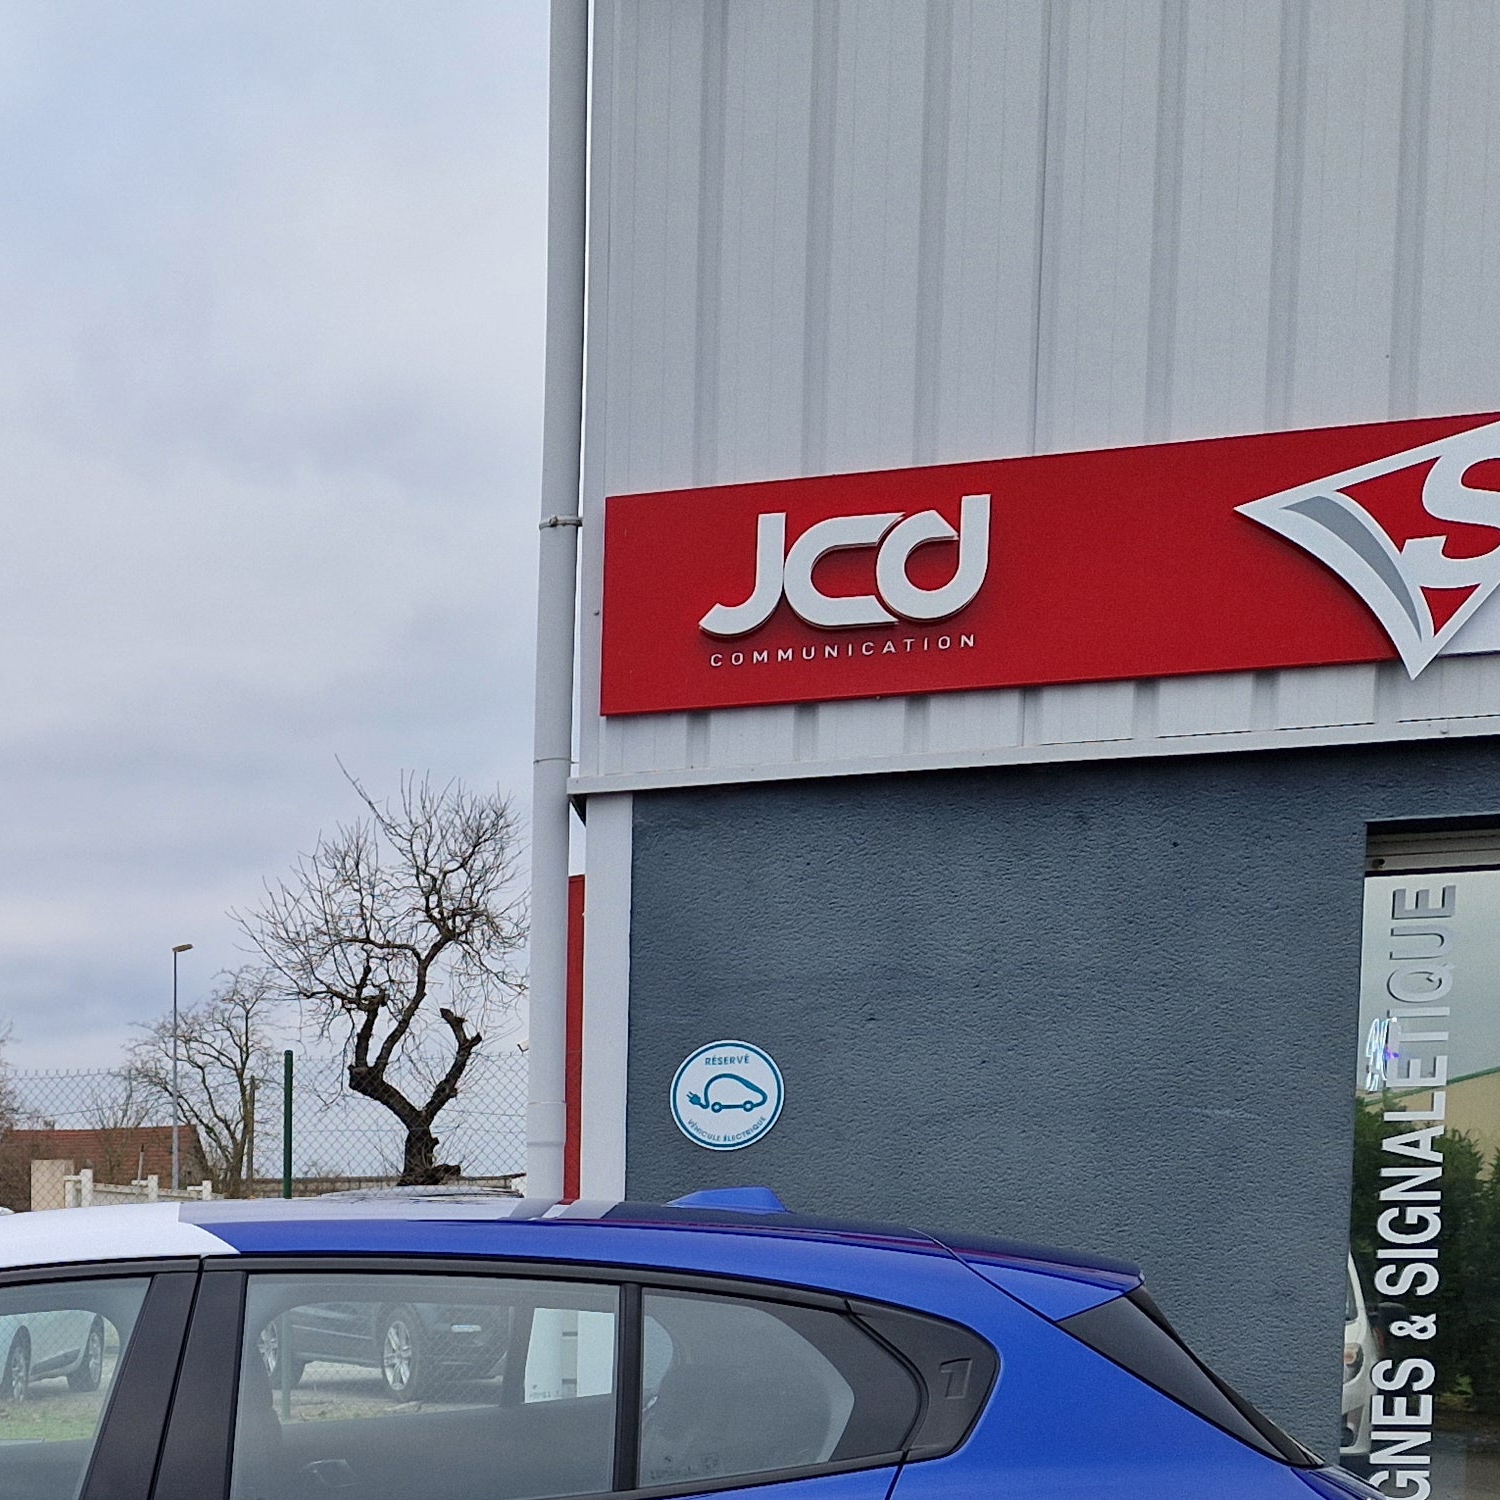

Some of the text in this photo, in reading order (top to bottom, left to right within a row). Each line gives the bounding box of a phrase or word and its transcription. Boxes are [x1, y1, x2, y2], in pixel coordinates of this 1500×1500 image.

[710, 633, 975, 668] COMMUNICATION
[705, 1054, 750, 1066] RÉSERVÉ
[1389, 1312, 1437, 1340] &
